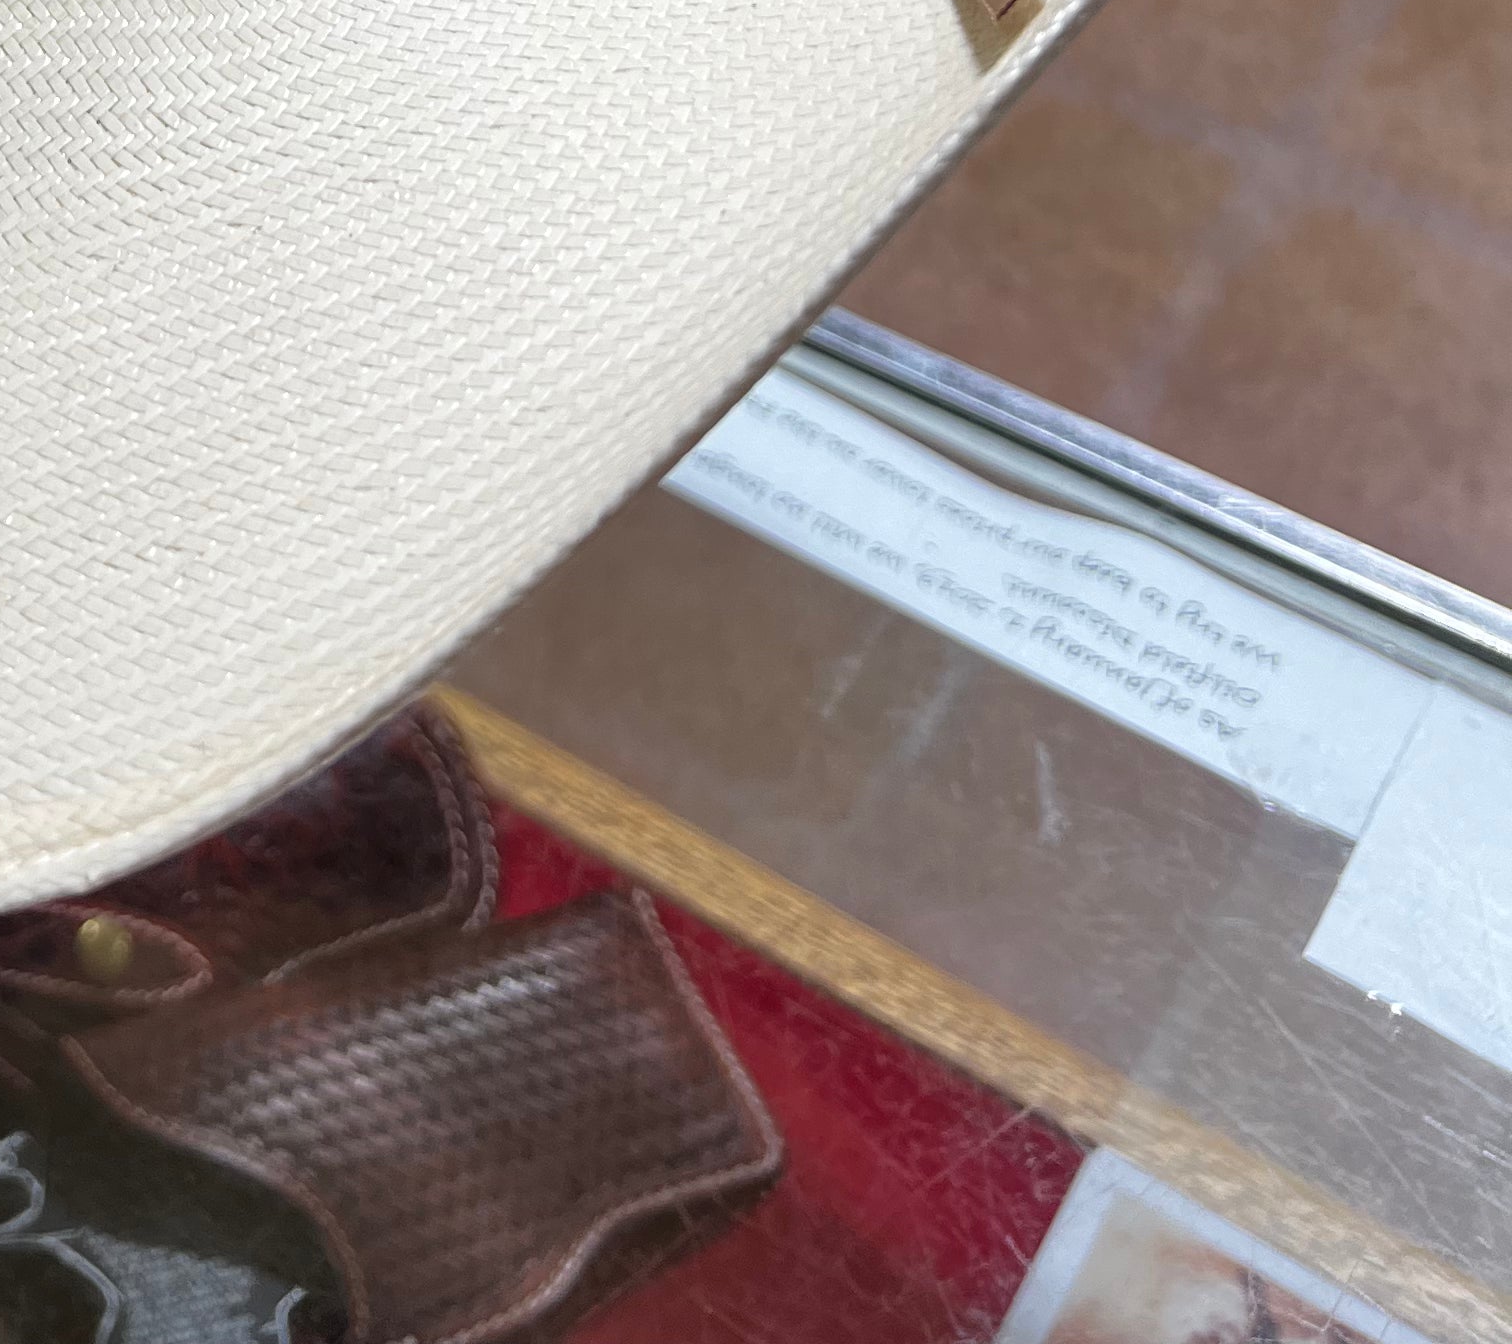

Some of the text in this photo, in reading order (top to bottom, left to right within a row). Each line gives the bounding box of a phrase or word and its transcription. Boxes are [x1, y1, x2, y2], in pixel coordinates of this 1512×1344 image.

[1138, 585, 1171, 614] to
[1175, 599, 1229, 644] try
[1029, 615, 1176, 700] January
[1139, 641, 1262, 709] Oilfield
[1231, 633, 1281, 673] We
